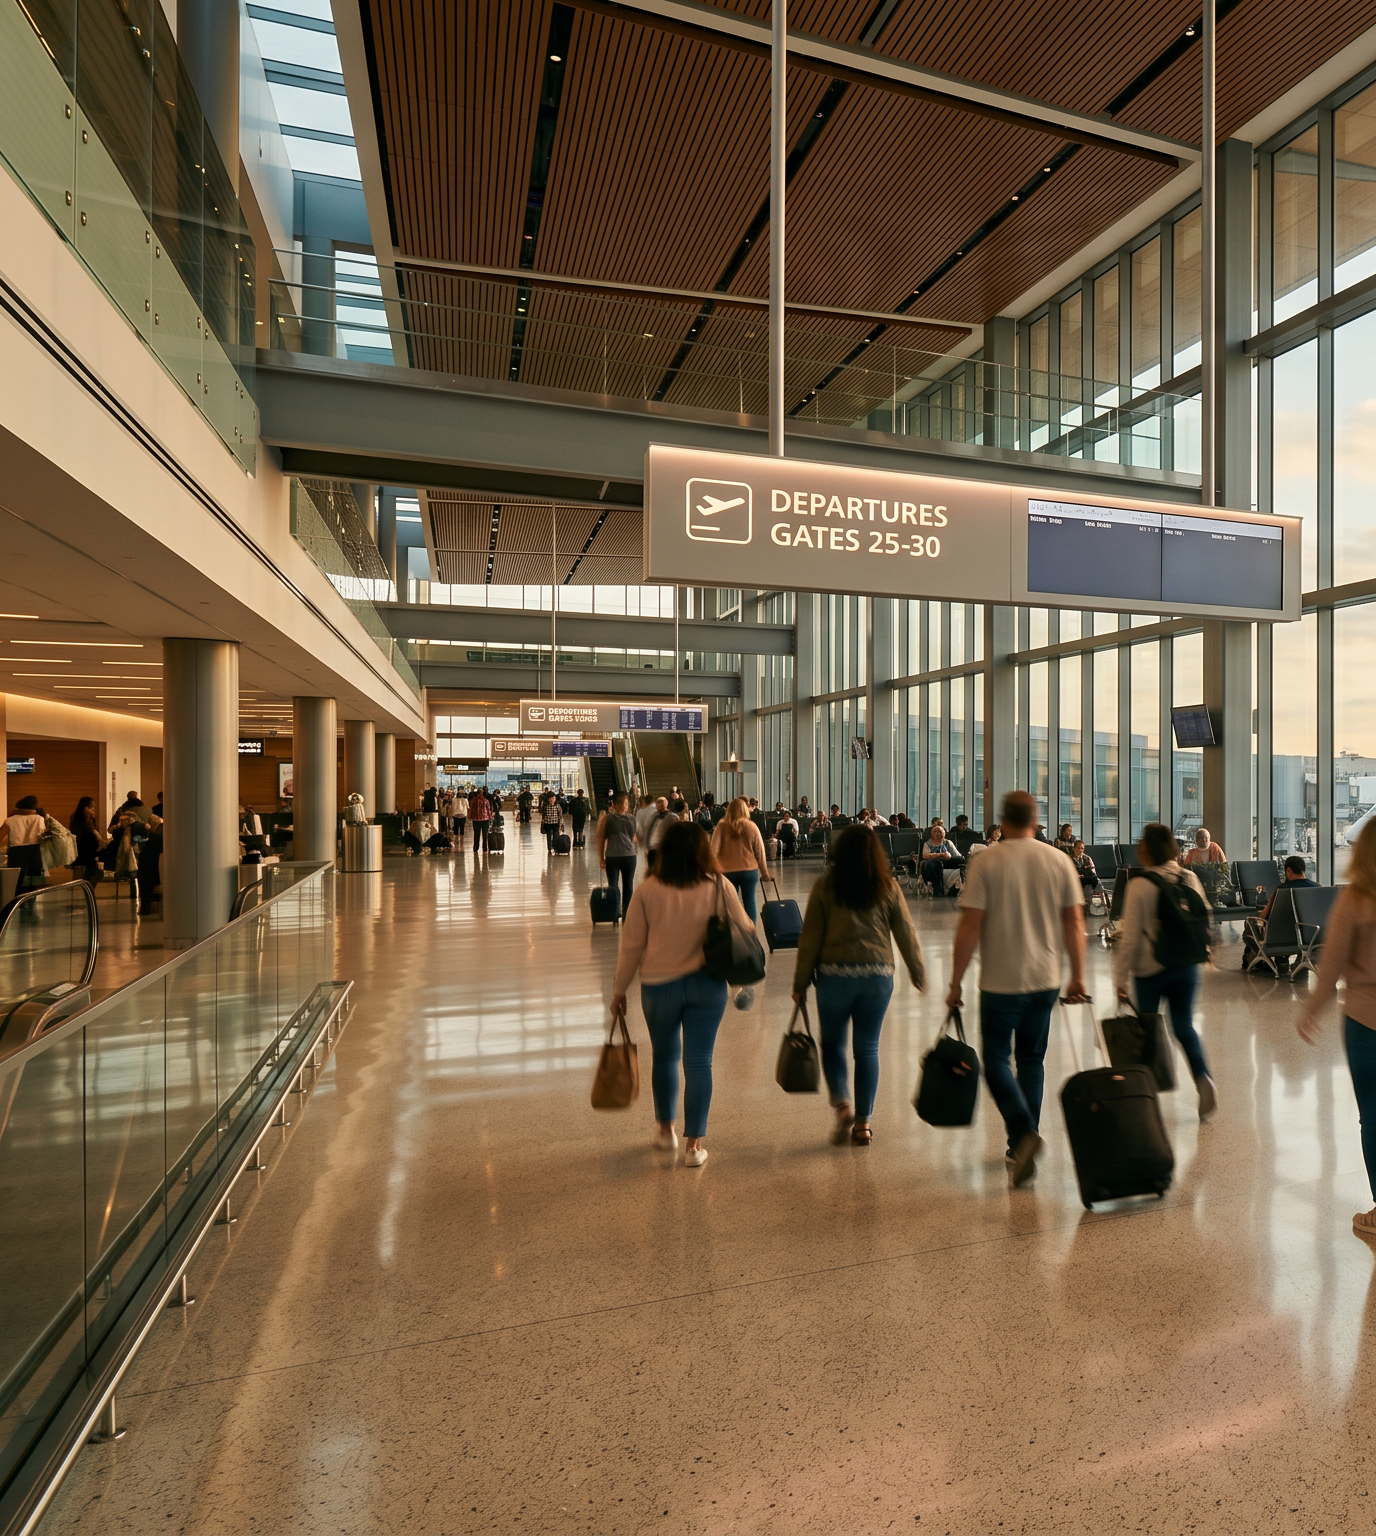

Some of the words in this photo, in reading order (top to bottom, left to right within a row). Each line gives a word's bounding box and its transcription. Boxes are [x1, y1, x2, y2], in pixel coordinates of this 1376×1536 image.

[770, 489, 948, 528] DEPARTURES
[770, 522, 860, 552] GATES
[868, 531, 941, 558] 25-30
